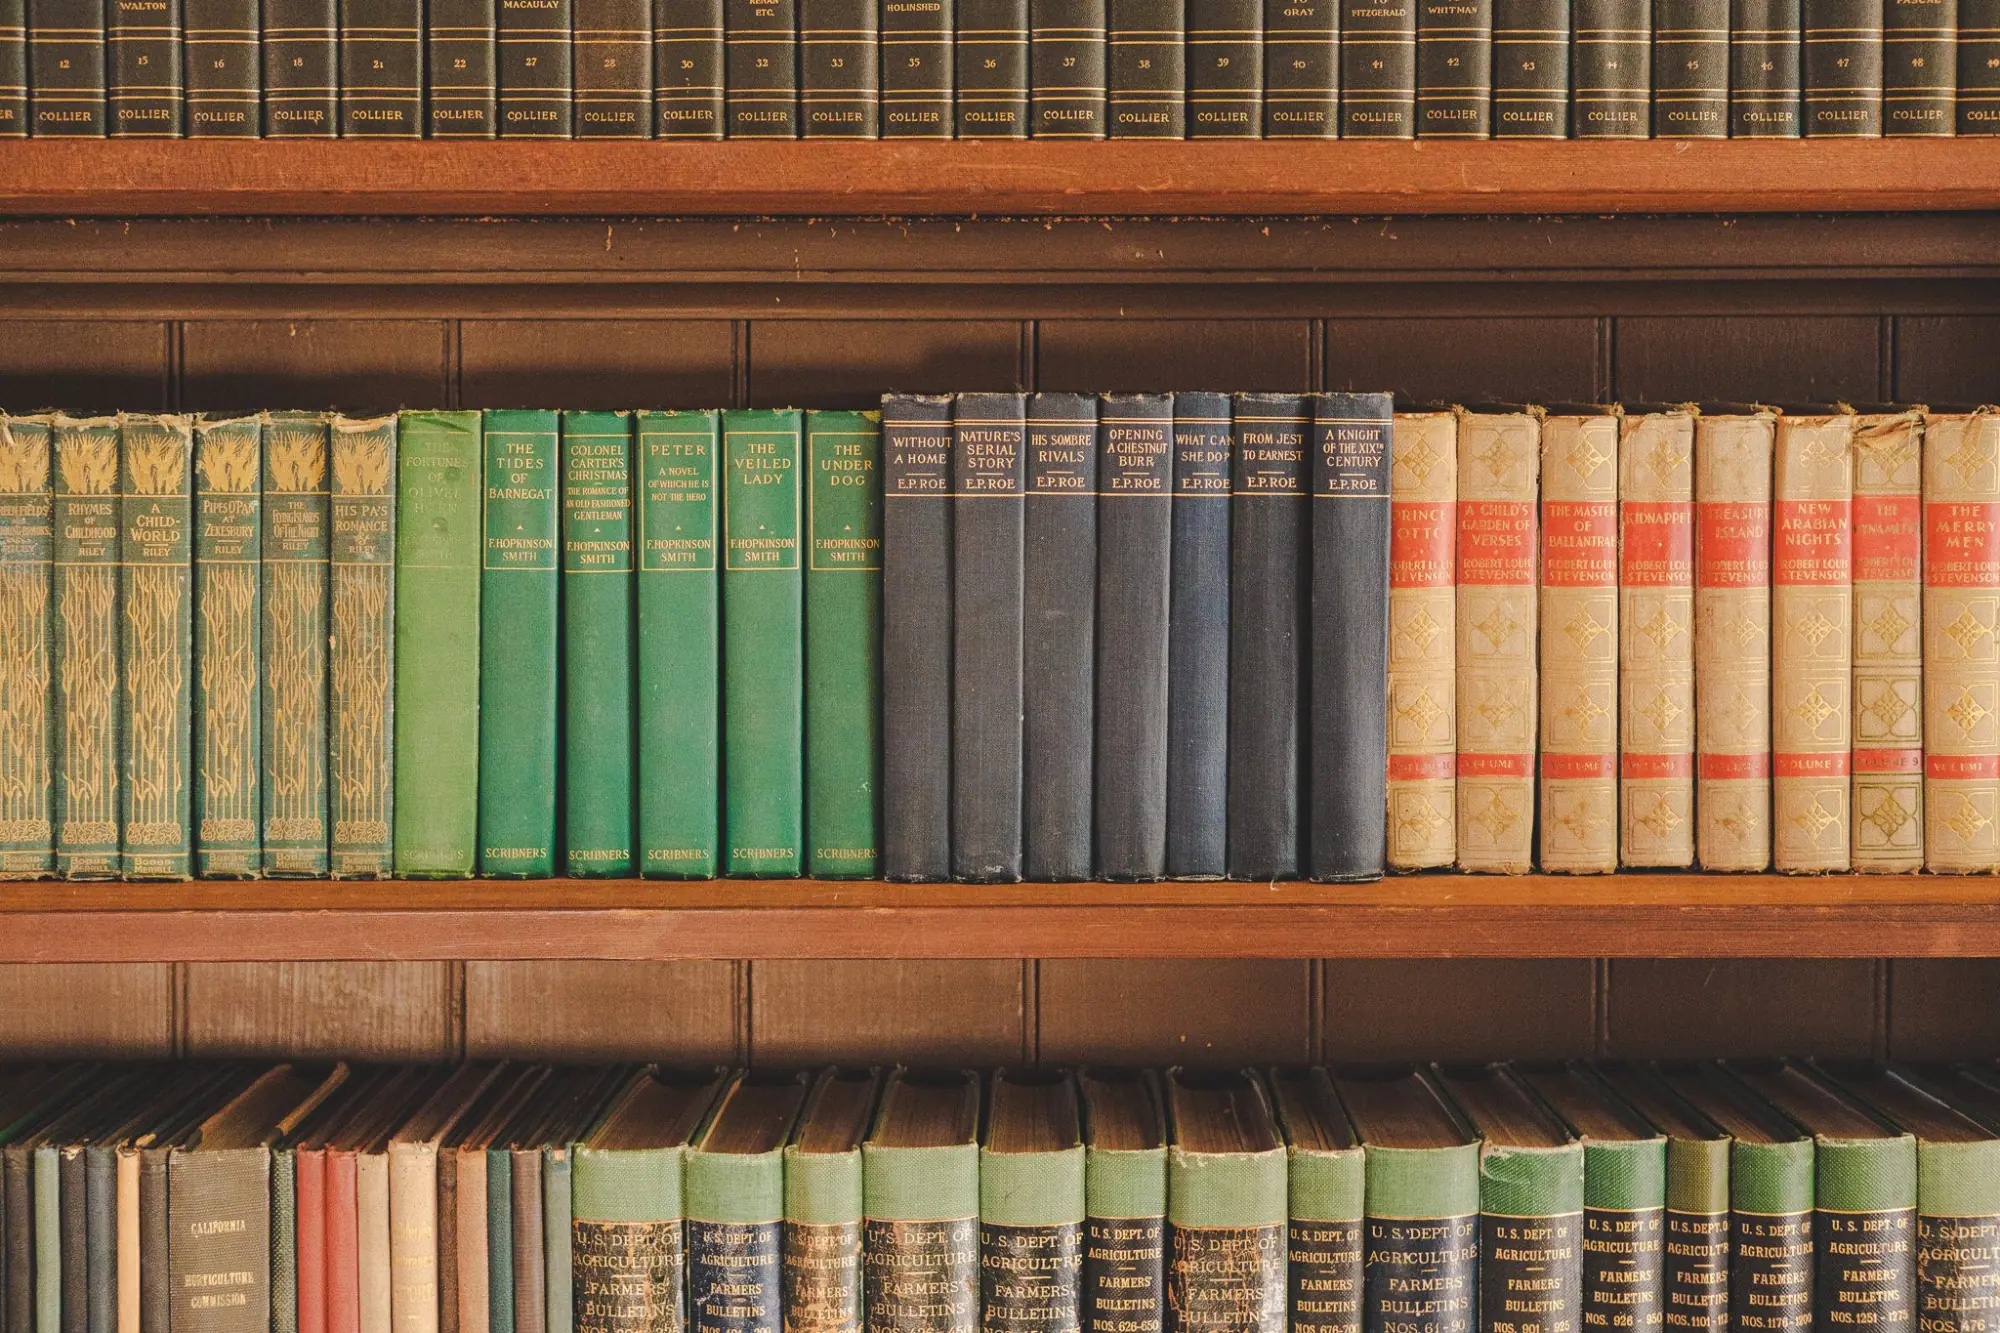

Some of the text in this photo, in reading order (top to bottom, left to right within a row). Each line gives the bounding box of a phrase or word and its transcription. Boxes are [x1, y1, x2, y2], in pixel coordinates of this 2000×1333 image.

[120, 1, 167, 10] WALTON
[887, 3, 940, 11] HOLINSHED
[1428, 6, 1478, 14] WHITMAN
[1284, 8, 1315, 16] GRAY
[1352, 9, 1407, 17] FITZGERALD
[138, 57, 148, 65] 15
[293, 58, 303, 66] 18
[525, 58, 537, 66] 27
[756, 59, 769, 67] 32
[831, 59, 843, 68] 33
[908, 58, 920, 67] 35
[984, 60, 996, 69] 36
[1063, 58, 1075, 66] 37
[1138, 60, 1150, 69] 38
[1217, 58, 1229, 67] 39
[1447, 58, 1460, 67] 42
[1837, 59, 1849, 68] 47
[1911, 58, 1924, 67] 48
[40, 112, 92, 121] COLLIER
[119, 109, 170, 119] COLLIER
[195, 112, 245, 122] COLLIER
[353, 110, 404, 120] COLLIER
[433, 109, 484, 119] COLLIER
[585, 112, 636, 122] COLLIER
[738, 112, 788, 122] COLLIER
[889, 112, 939, 122] COLLIER
[1044, 110, 1094, 120] COLLIER
[1119, 113, 1169, 123] COLLIER
[1273, 112, 1324, 122] COLLIER
[1427, 109, 1478, 120] COLLIER
[1668, 112, 1719, 121] COLLIER
[1893, 110, 1944, 120] COLLIER
[960, 430, 1021, 443] NATURE'S
[1032, 434, 1092, 446] HIS SOMBRE
[1110, 429, 1163, 441] OPENING
[1176, 434, 1236, 446] WHAT CAN
[1243, 433, 1304, 445] FROM JEST
[1326, 430, 1380, 441] A KNIGHT
[506, 443, 534, 454] THE
[748, 443, 776, 454] THE
[893, 436, 952, 449] WITHOUT
[1107, 443, 1168, 454] A CHESTNUT
[1323, 443, 1357, 454] OF THE
[570, 445, 623, 456] COLONEL
[651, 444, 706, 456] PETER
[834, 444, 862, 456] THE
[967, 444, 1016, 456] SERIAL
[1243, 450, 1303, 461] TO EARNEST
[894, 453, 946, 464] A HOME
[1039, 450, 1085, 463] RIVALS
[1118, 455, 1154, 467] BURR
[1181, 451, 1231, 462] SHE DO?
[1327, 456, 1381, 468] CENTURY
[496, 458, 544, 469] TIDES
[570, 458, 624, 469] CARTER'S
[735, 458, 791, 470] VEILED
[821, 459, 873, 471] UNDER
[968, 457, 1014, 470] STORY
[568, 470, 627, 481] CHRISTMAS
[659, 467, 700, 476] A NOVEL
[511, 472, 528, 484] OF
[744, 474, 783, 486] LADY
[831, 475, 865, 487] DOG
[489, 488, 552, 500] BARNEGAT
[582, 486, 616, 496] ROMANCE
[618, 486, 629, 496] OF
[652, 493, 706, 502] NOT THE HERO
[67, 503, 113, 516] RHYMES
[152, 503, 161, 514] A
[287, 501, 306, 510] THE
[335, 505, 388, 517] HIS PA'S
[1465, 504, 1529, 516] A CHILD'S
[1551, 505, 1570, 517] THE
[1798, 503, 1832, 514] NEW
[1950, 505, 1981, 517] THE
[136, 515, 181, 528] CHILD-
[222, 515, 236, 524] AT
[574, 510, 623, 521] GENTLEMAN
[204, 524, 255, 537] ZEKESBURY
[335, 520, 388, 532] ROMANCE
[1515, 520, 1531, 531] OF
[1781, 518, 1847, 531] ARABIAN
[1936, 521, 1996, 533] MERRY
[65, 526, 117, 539] CHILDHOOD
[131, 527, 181, 542] WORLD
[1472, 534, 1522, 546] VERSES
[1785, 533, 1842, 545] NIGHTS
[1946, 537, 1984, 548] MEN
[79, 547, 106, 557] RILEY
[143, 546, 171, 557] RILEY
[214, 545, 243, 555] RILEY
[503, 551, 537, 562] SMITH
[661, 552, 696, 562] SMITH
[744, 551, 780, 562] SMITH
[485, 847, 547, 859] SCRIBNERS
[648, 848, 710, 860] SCRIBNERS
[732, 847, 794, 859] SCRIBNERS
[191, 1220, 246, 1235] CALIFORNIA
[1408, 1224, 1473, 1239] DEPT. OF
[1114, 1226, 1160, 1242] DEPT. OF
[1314, 1229, 1360, 1242] DEPT. OF
[1523, 1227, 1568, 1241] DEPT. OF
[1583, 1239, 1659, 1253] AGRICULTURE
[1740, 1243, 1813, 1258] AGRICULTURE
[1830, 1241, 1907, 1254] AGRICULTURE
[701, 1253, 774, 1267] AGRICULTURE
[1088, 1247, 1162, 1261] AGRICULTURE
[1289, 1250, 1362, 1263] AGRICULTURE
[1369, 1247, 1477, 1265] AGRICULTURE
[1495, 1247, 1573, 1261] AGRICULTURE
[184, 1271, 254, 1287] HORTICULTURE
[191, 1293, 246, 1309] COMMISSION
[1594, 1291, 1654, 1304] BULLETINS
[1749, 1293, 1808, 1306] BULLETINS
[1839, 1290, 1900, 1303] BULLETINS
[706, 1304, 766, 1317] BULLETINS
[1096, 1298, 1155, 1311] BULLETINS
[1297, 1300, 1356, 1312] BULLETINS
[1381, 1297, 1468, 1313] BULLETINS
[1505, 1299, 1565, 1312] BULLETINS
[1586, 1312, 1609, 1326] NOS.
[1831, 1311, 1854, 1324] NOS.
